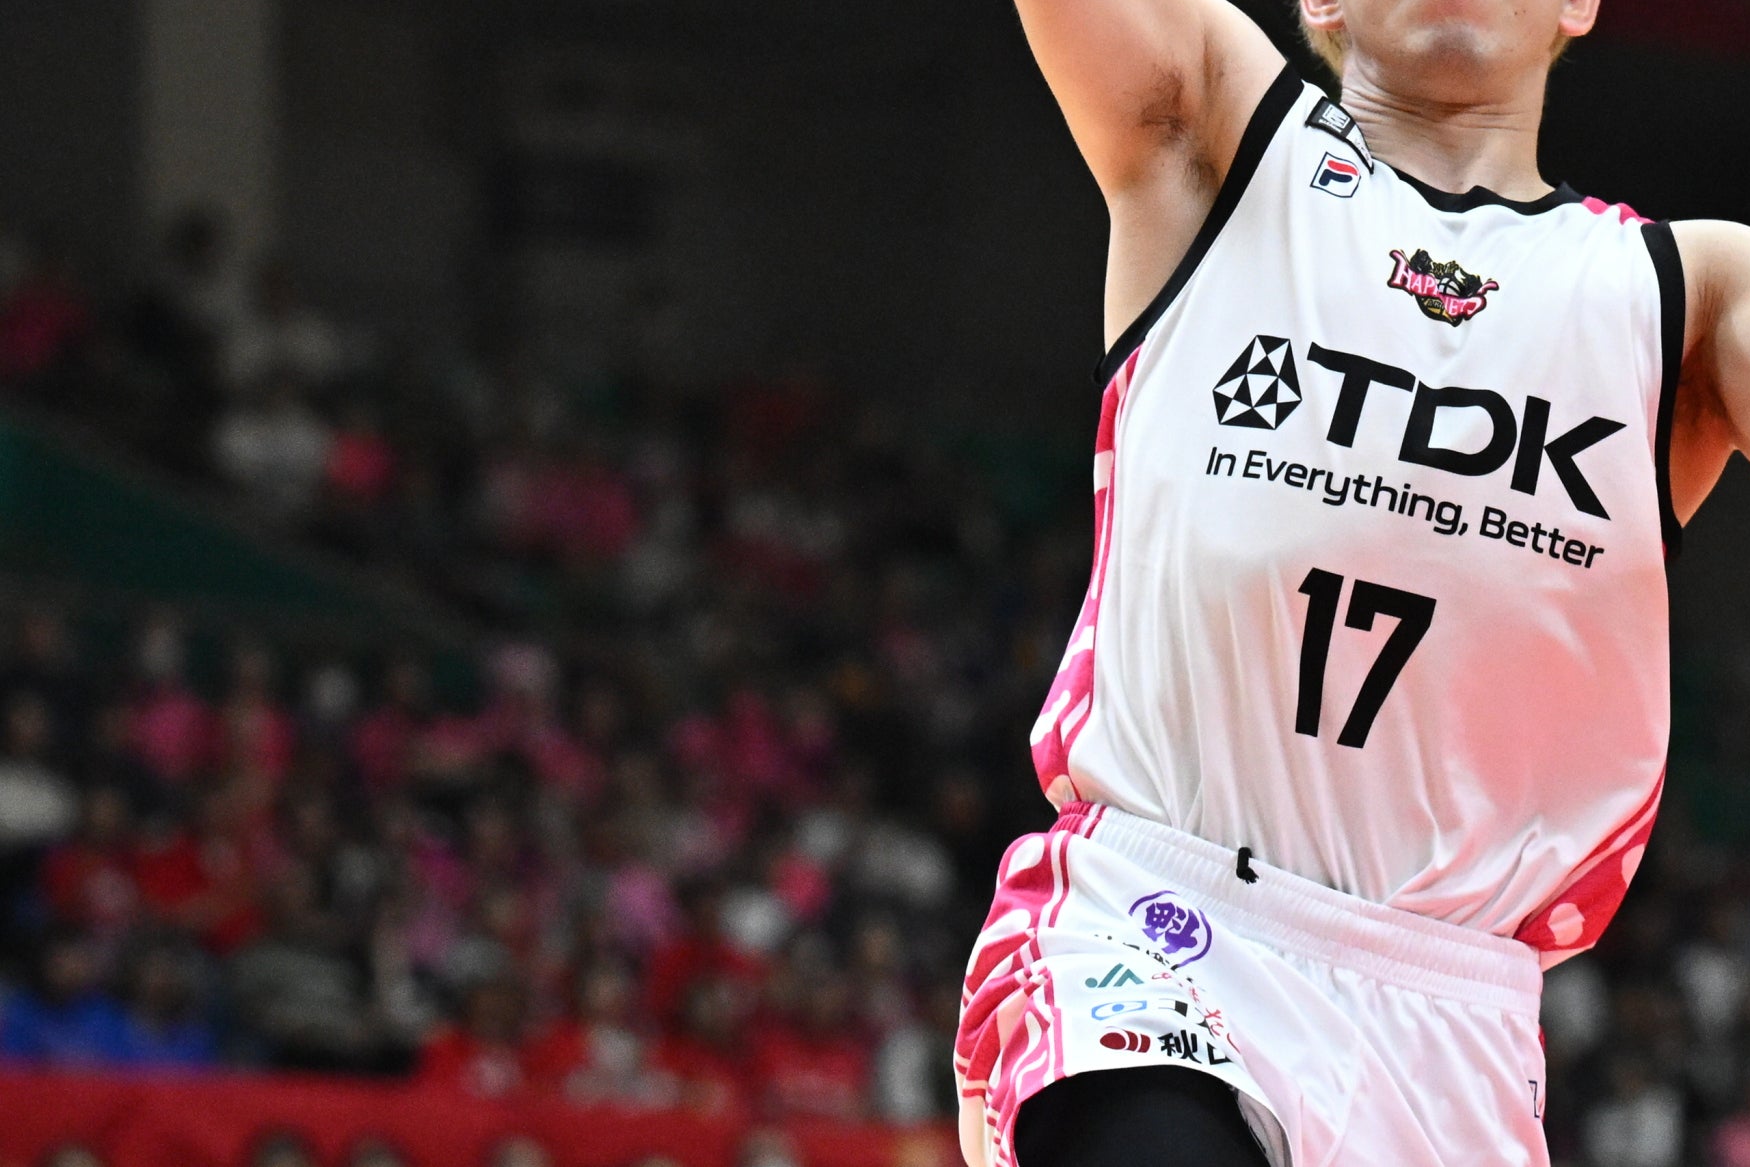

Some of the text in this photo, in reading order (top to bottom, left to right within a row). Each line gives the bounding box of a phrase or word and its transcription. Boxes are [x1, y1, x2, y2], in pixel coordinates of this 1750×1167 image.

[1206, 446, 1605, 569] In Everything, Better
[1307, 341, 1628, 521] TDK
[1295, 567, 1437, 749] 17
